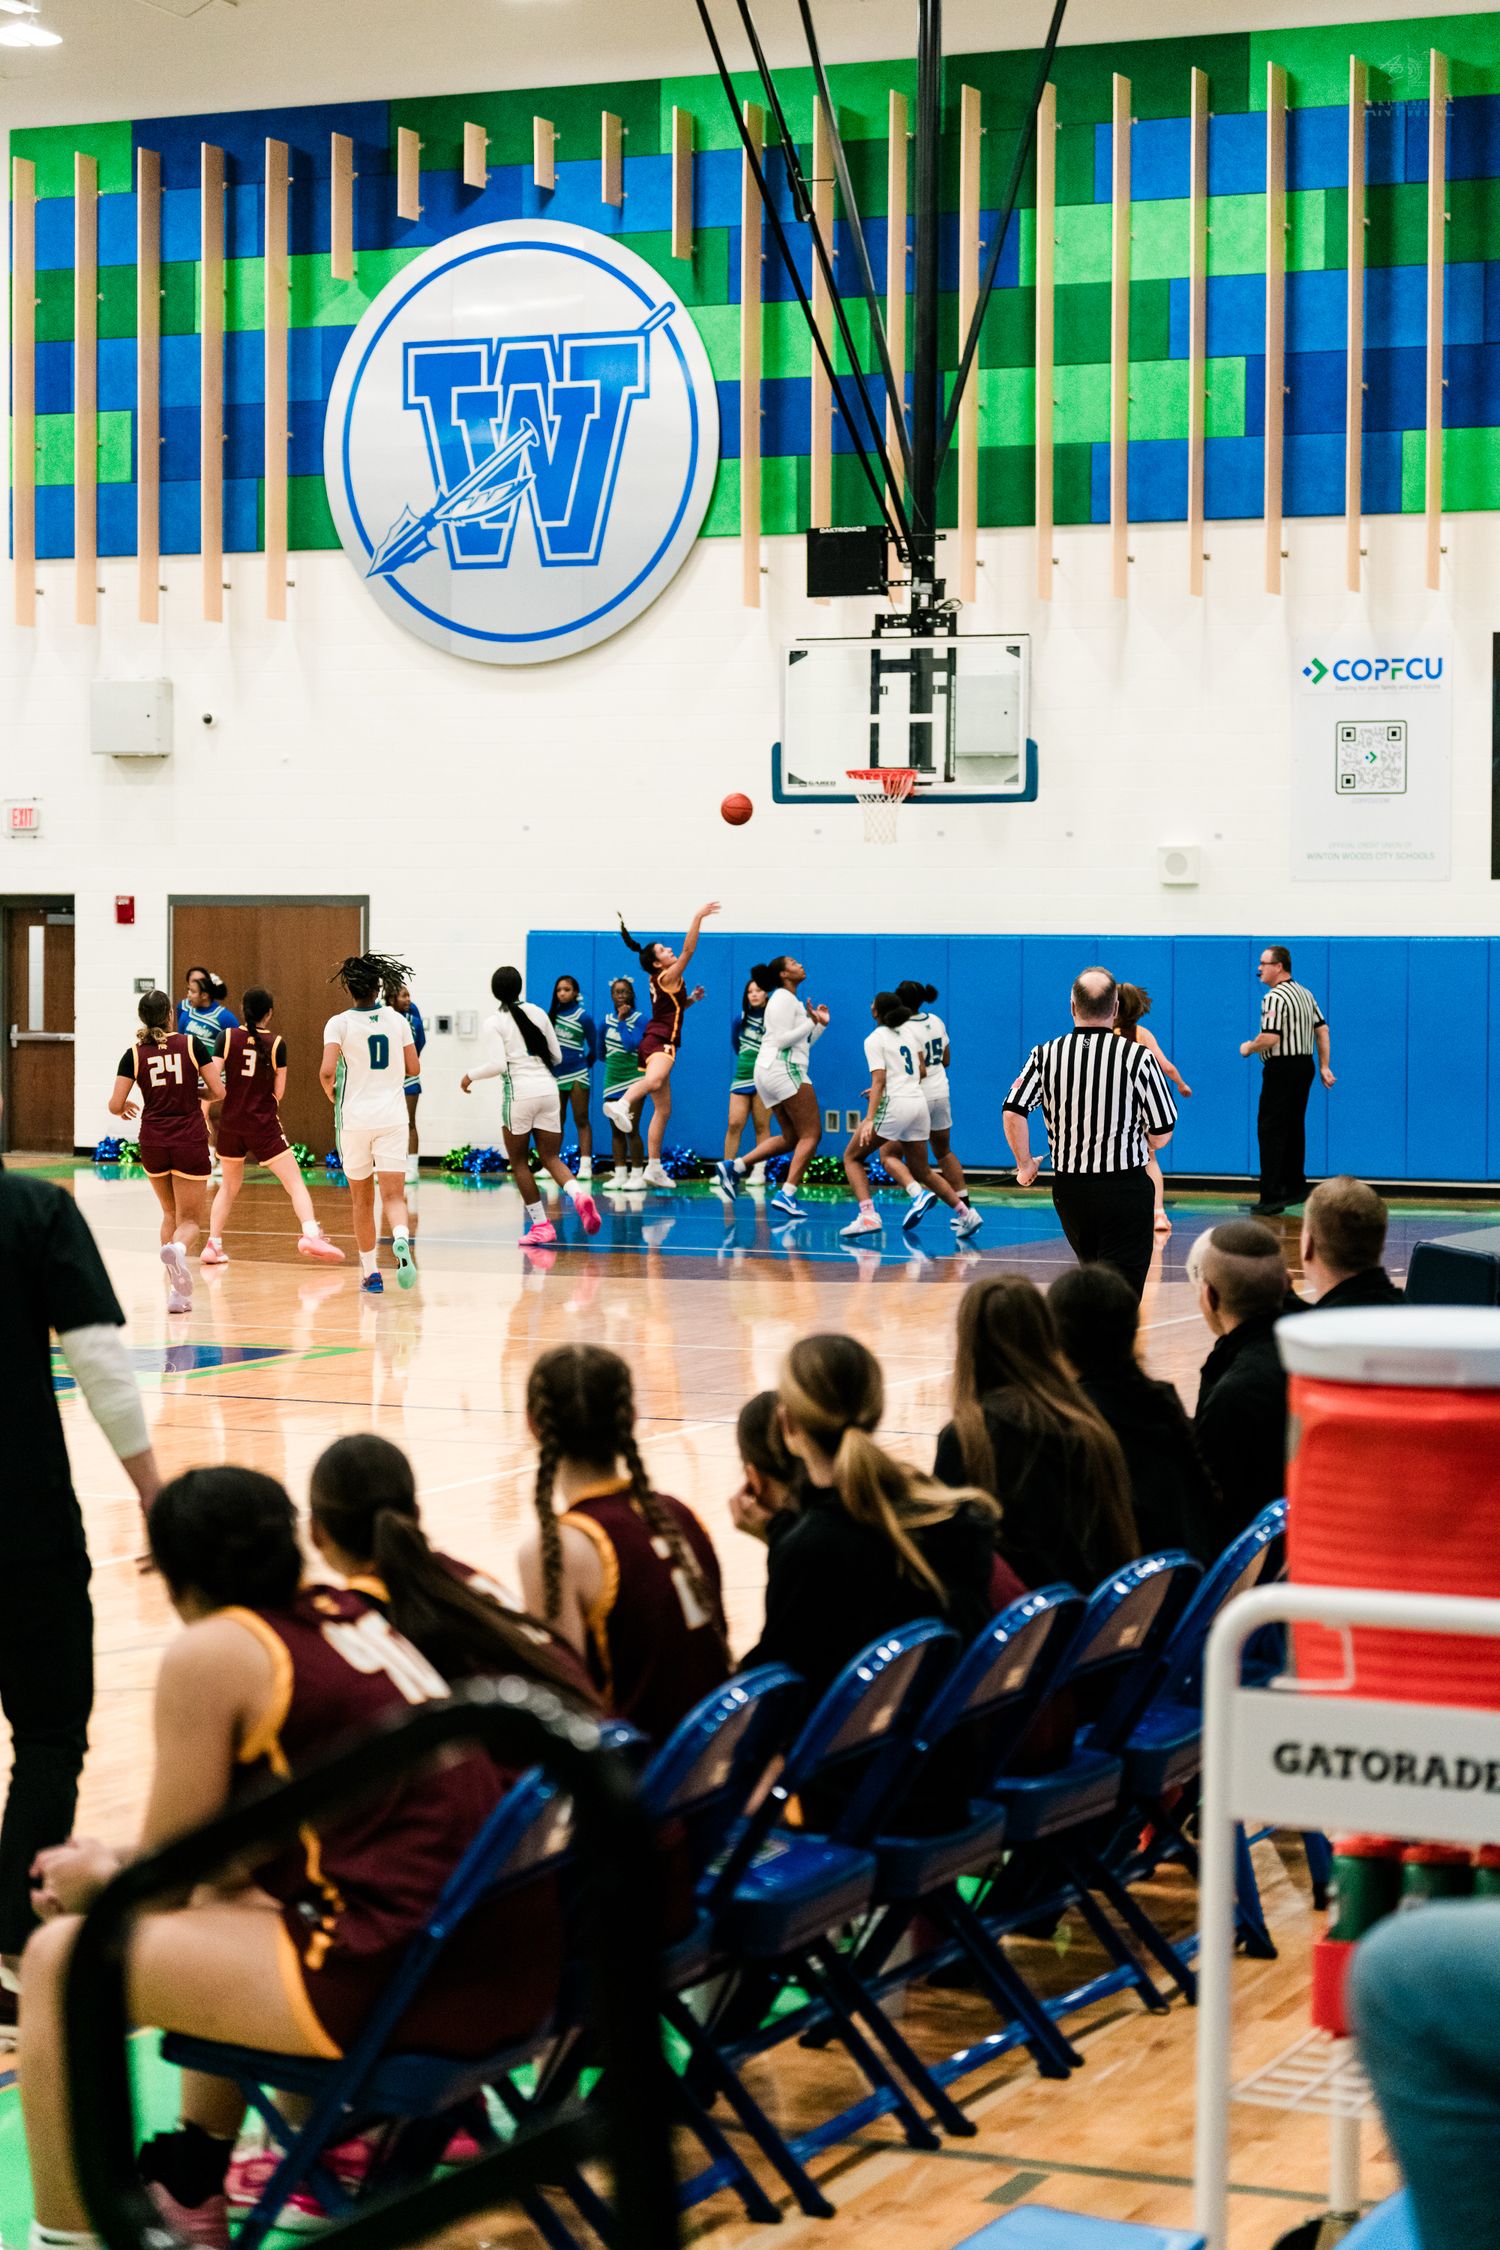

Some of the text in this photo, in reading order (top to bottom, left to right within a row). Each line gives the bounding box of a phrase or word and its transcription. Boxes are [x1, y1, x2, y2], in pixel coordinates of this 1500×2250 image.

[1333, 657, 1443, 682] COPFCU
[12, 807, 33, 827] EXIT
[1306, 851, 1436, 860] WINTON WOODS CITY SCHOOLS
[241, 1048, 257, 1077] 3
[368, 1034, 389, 1070] 0
[900, 1045, 913, 1075] 3
[924, 1037, 944, 1067] 15
[147, 1053, 183, 1087] 24
[1272, 1741, 1500, 1795] GATORADE
